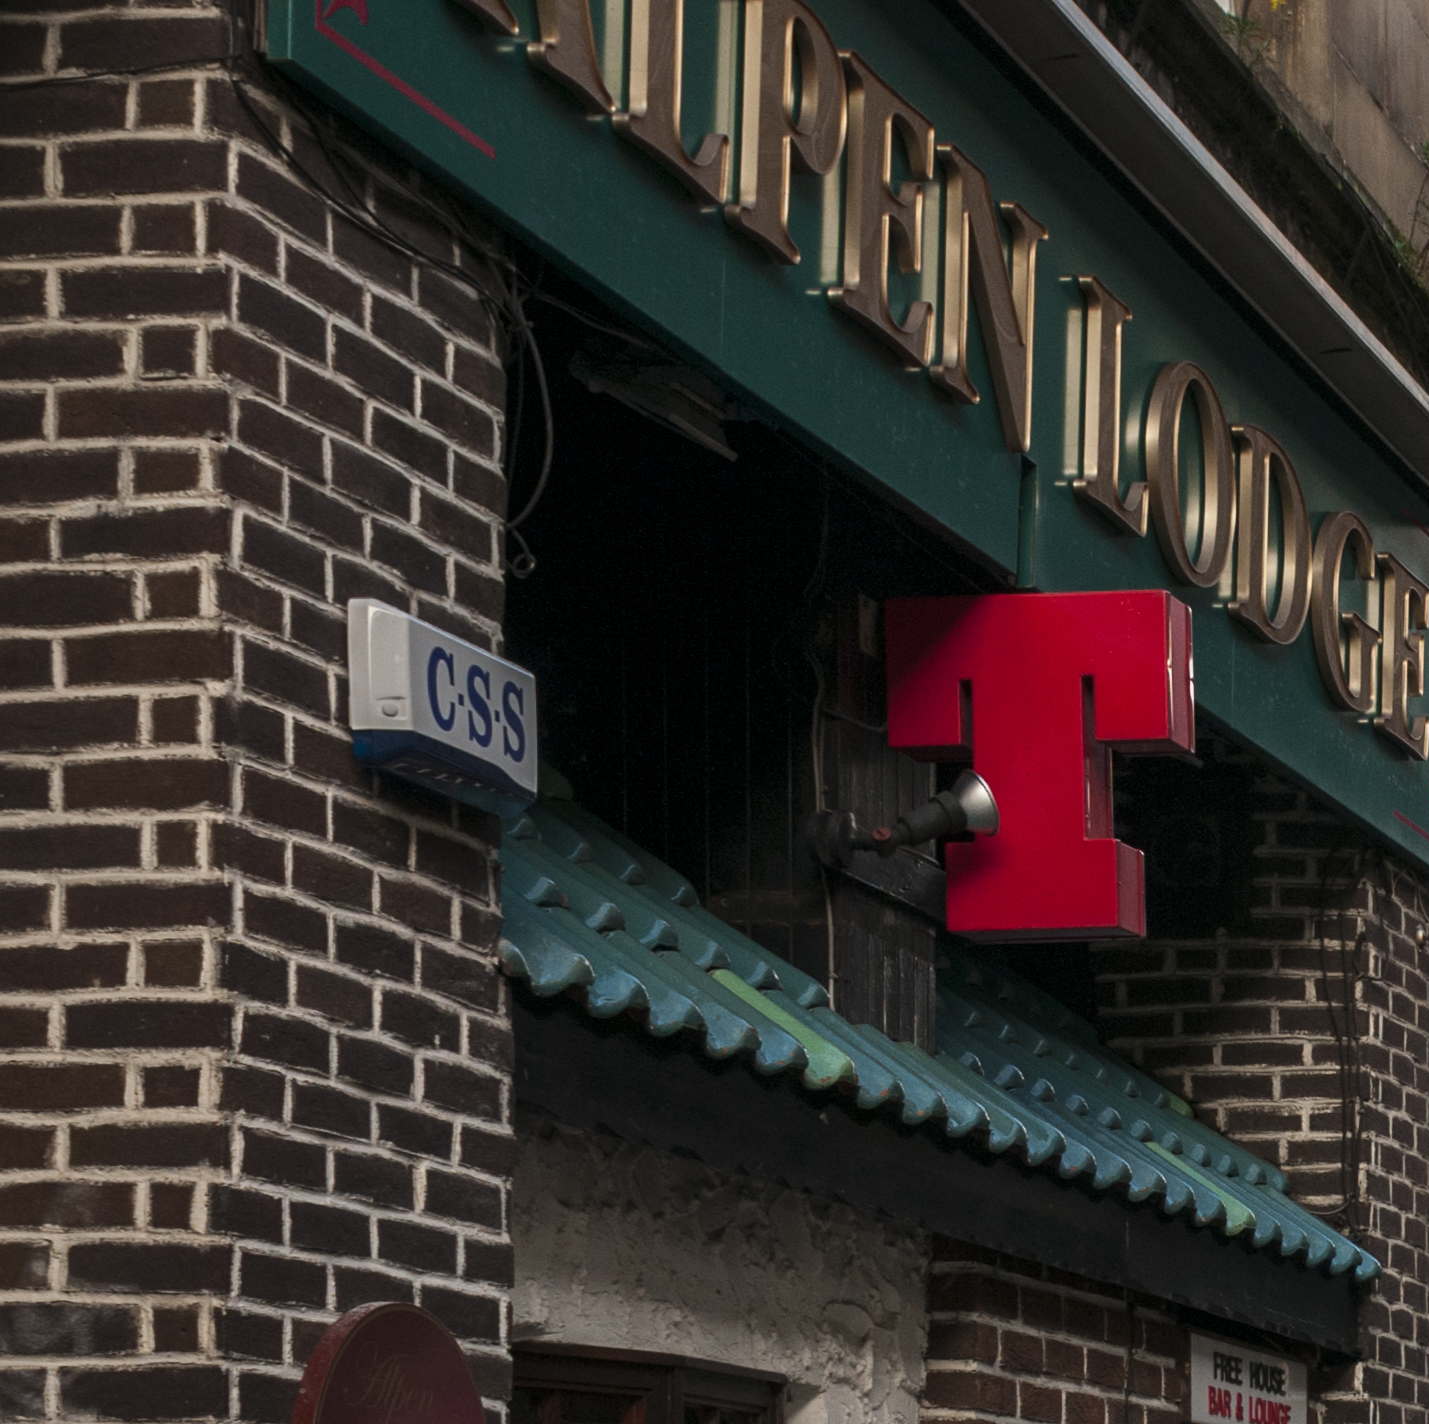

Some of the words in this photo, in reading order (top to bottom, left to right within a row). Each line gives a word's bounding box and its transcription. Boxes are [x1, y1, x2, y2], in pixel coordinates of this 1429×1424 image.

[1213, 1351, 1243, 1386] FREE
[1249, 1361, 1287, 1397] HOUSE
[1208, 1386, 1232, 1418] BAR
[1235, 1392, 1243, 1423] &
